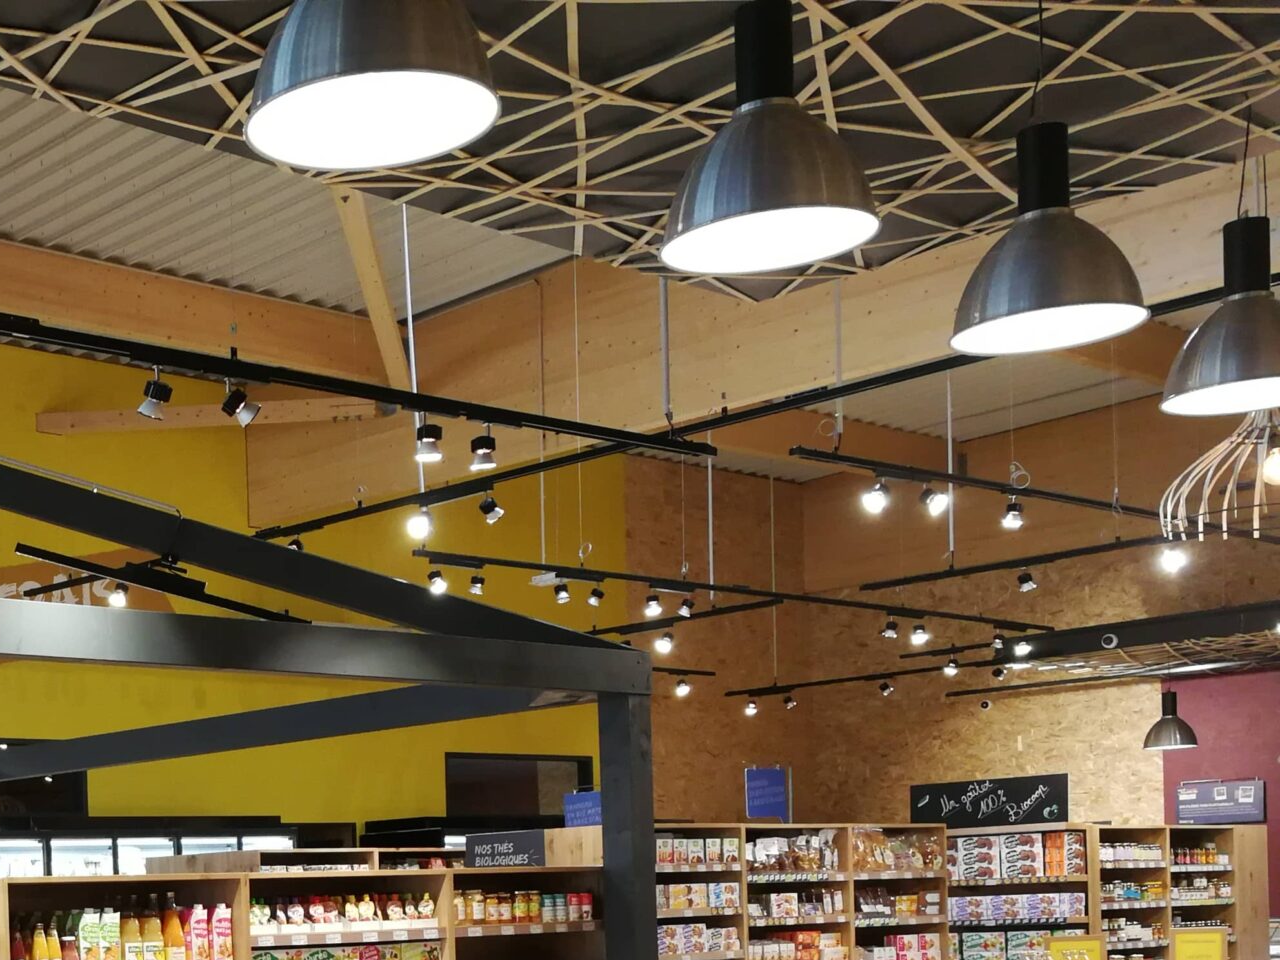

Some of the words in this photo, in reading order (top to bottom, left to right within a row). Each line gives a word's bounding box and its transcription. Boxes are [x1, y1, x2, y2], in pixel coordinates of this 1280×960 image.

[961, 780, 994, 812] goûter
[1003, 784, 1048, 822] Biocoop
[475, 844, 492, 855] NOS
[493, 841, 514, 853] THÉS
[475, 854, 529, 867] BIOLOGIQUES
